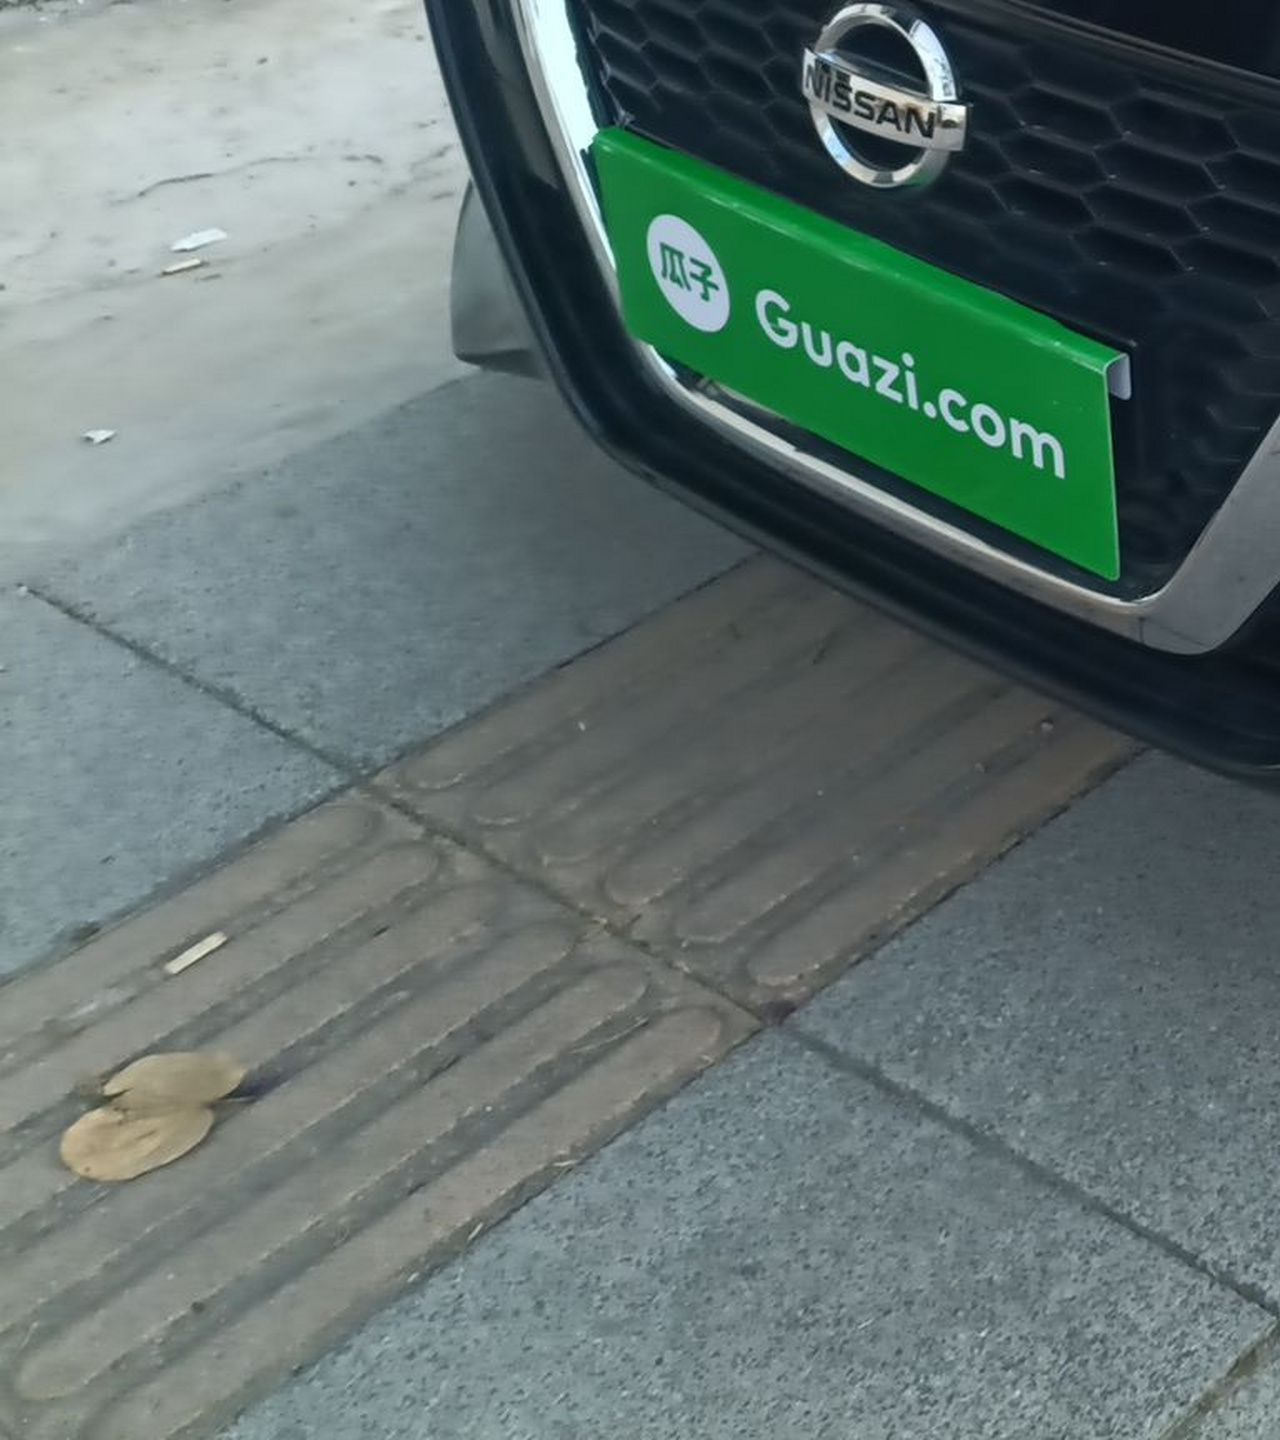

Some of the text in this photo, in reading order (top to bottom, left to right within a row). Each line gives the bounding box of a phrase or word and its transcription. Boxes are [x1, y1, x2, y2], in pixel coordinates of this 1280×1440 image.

[805, 63, 936, 139] NISSAN
[659, 241, 720, 302] 瓜子
[754, 288, 1066, 479] Guazi.com
